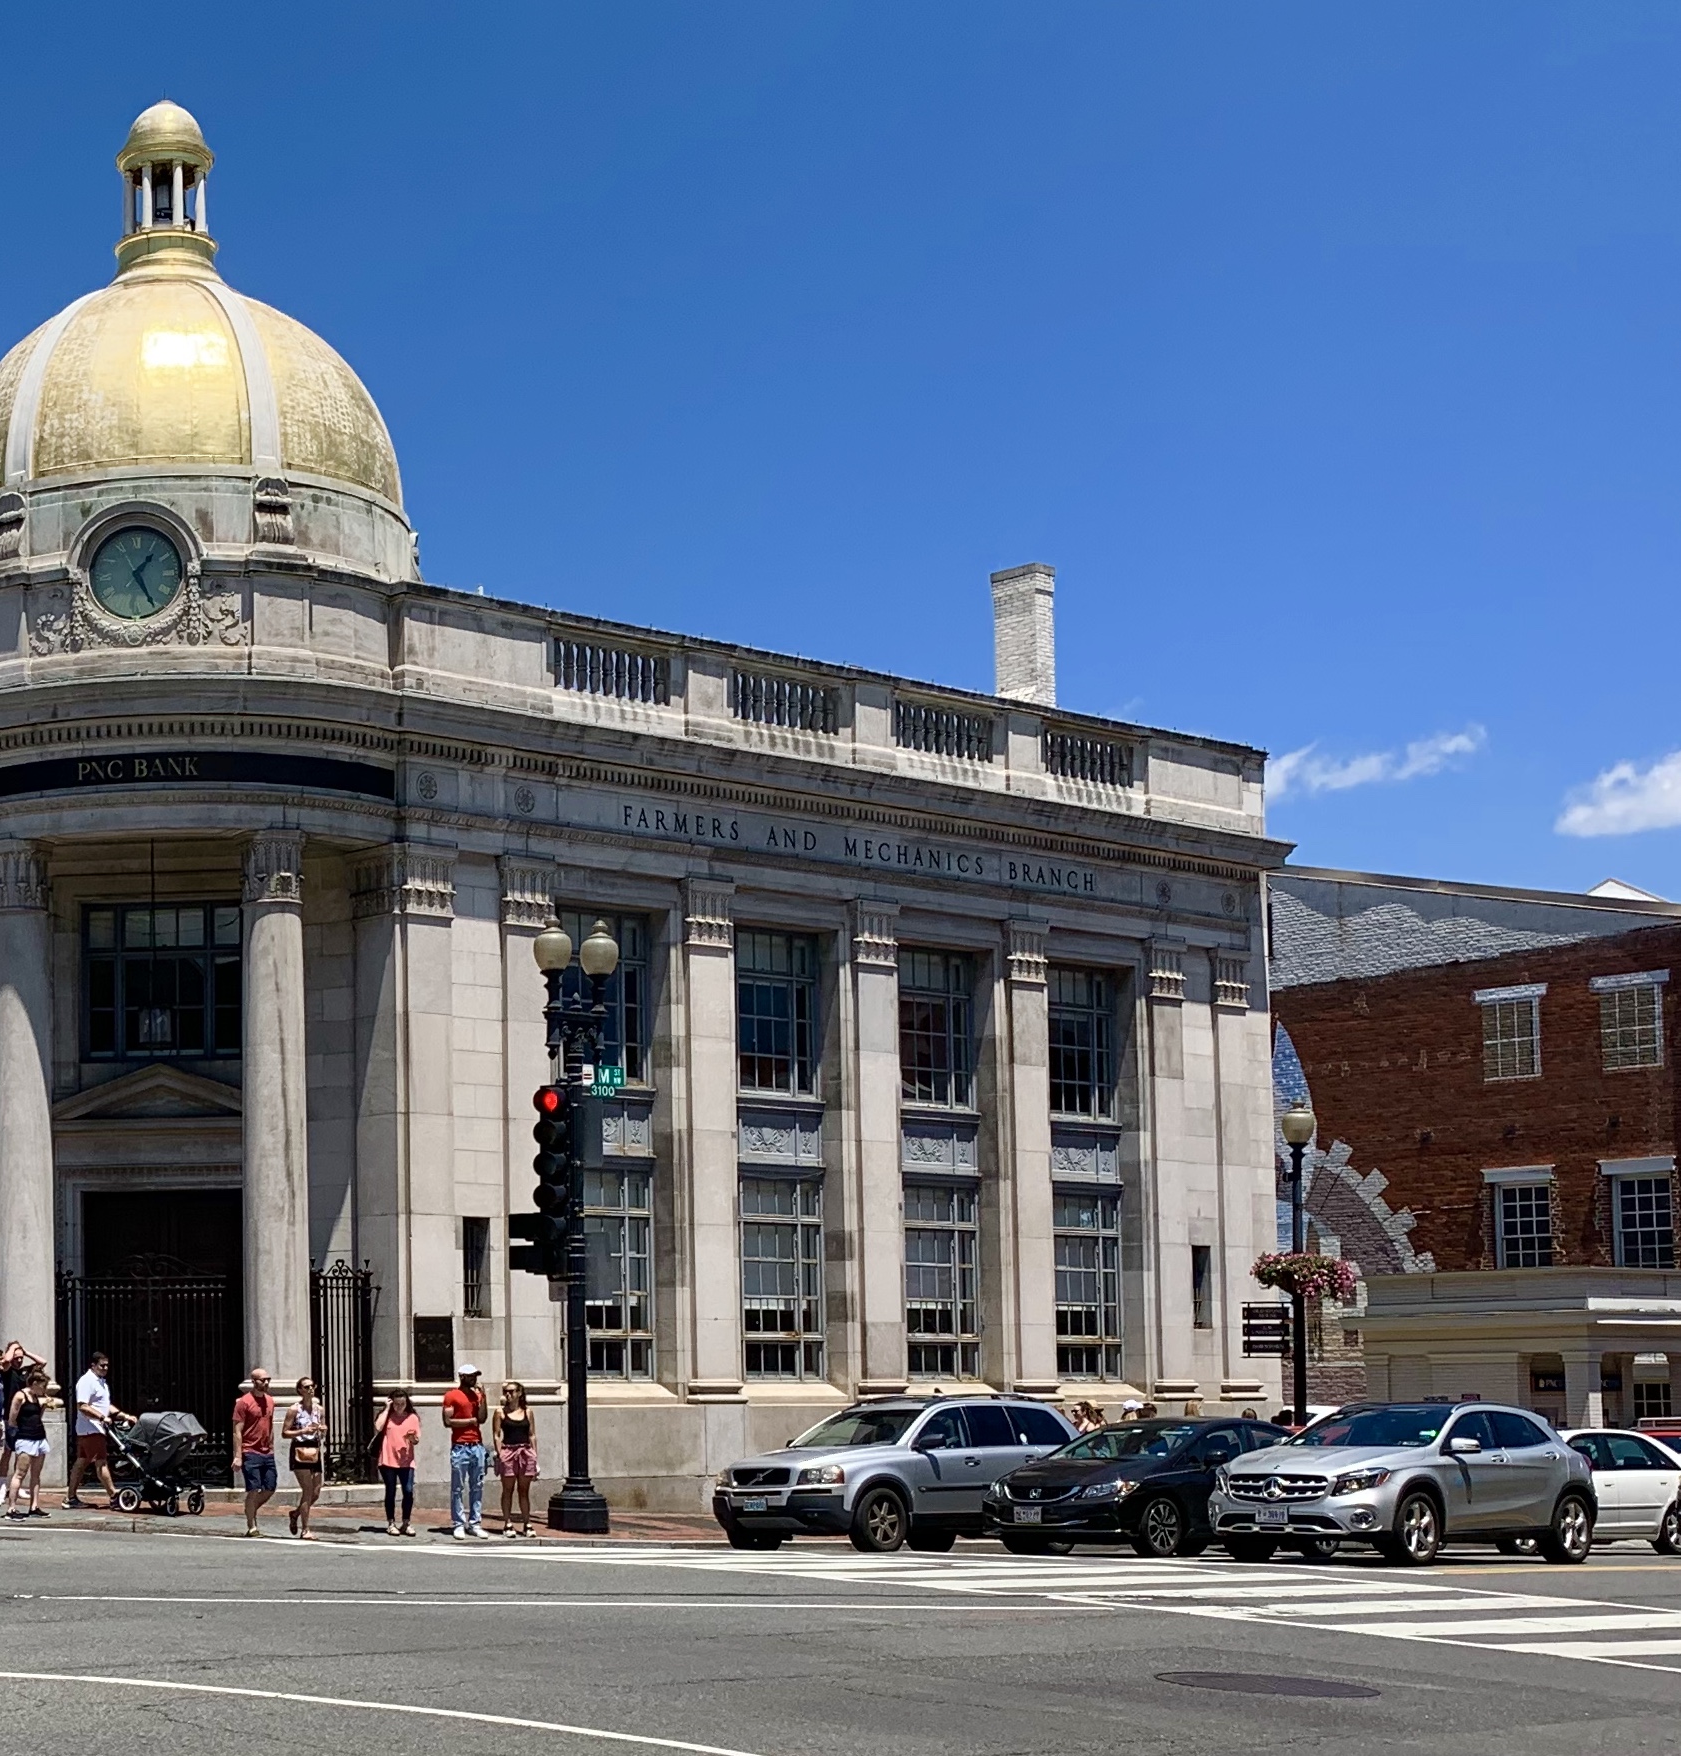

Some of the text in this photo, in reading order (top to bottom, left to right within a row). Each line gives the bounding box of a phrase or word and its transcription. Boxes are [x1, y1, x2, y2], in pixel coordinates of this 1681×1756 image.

[78, 757, 199, 780] PNC BANK
[623, 805, 1095, 892] FARMERS AND MECHANICS BRANCH
[598, 1068, 610, 1084] M
[591, 1084, 615, 1097] 3100
